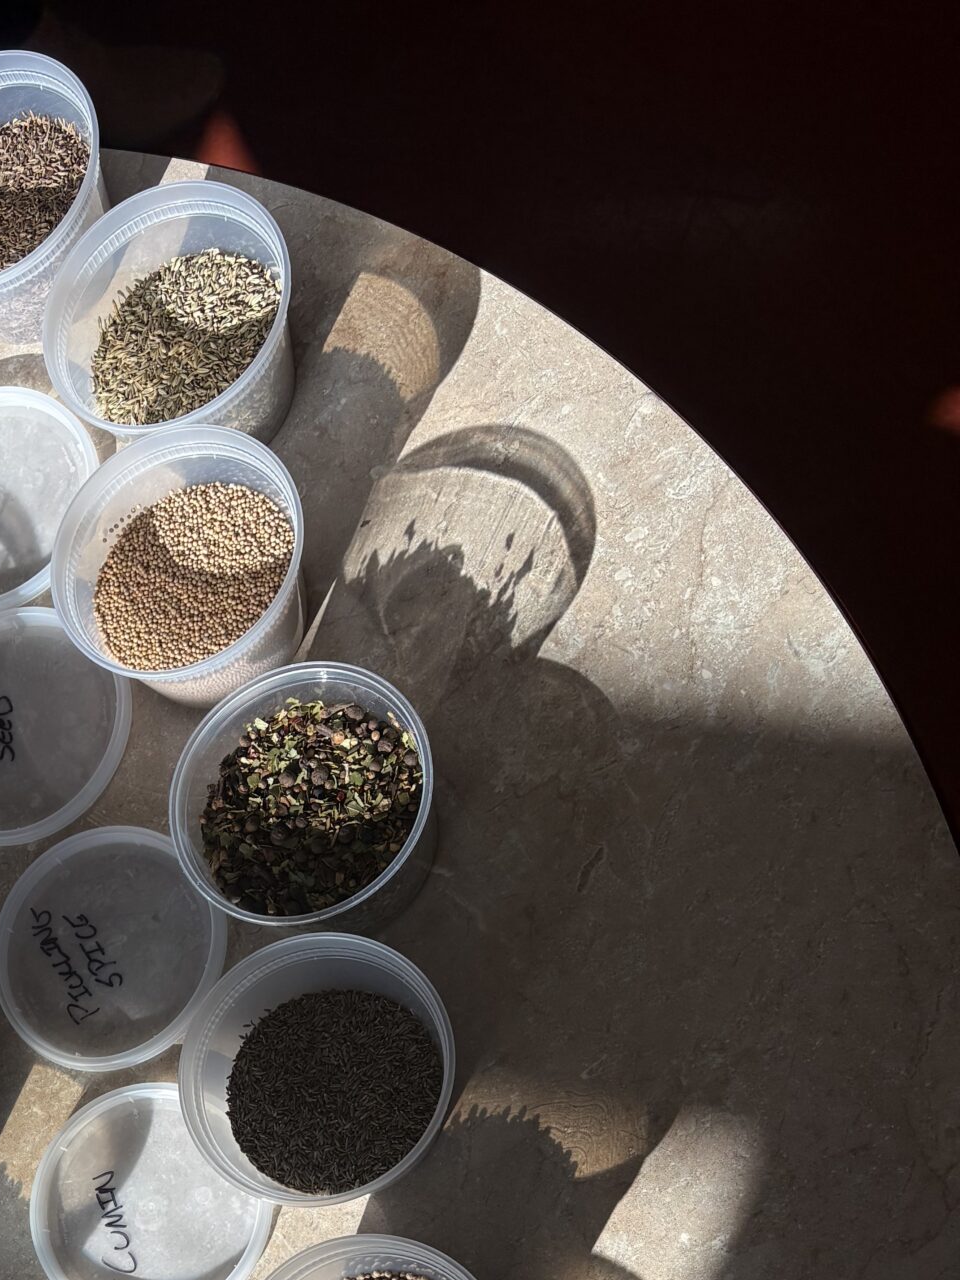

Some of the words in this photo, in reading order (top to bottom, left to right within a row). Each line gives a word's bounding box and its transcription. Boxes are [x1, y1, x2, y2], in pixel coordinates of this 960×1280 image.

[29, 907, 100, 1025] PICKLING
[63, 914, 123, 989] SPICE
[92, 1170, 138, 1274] CUMIN
